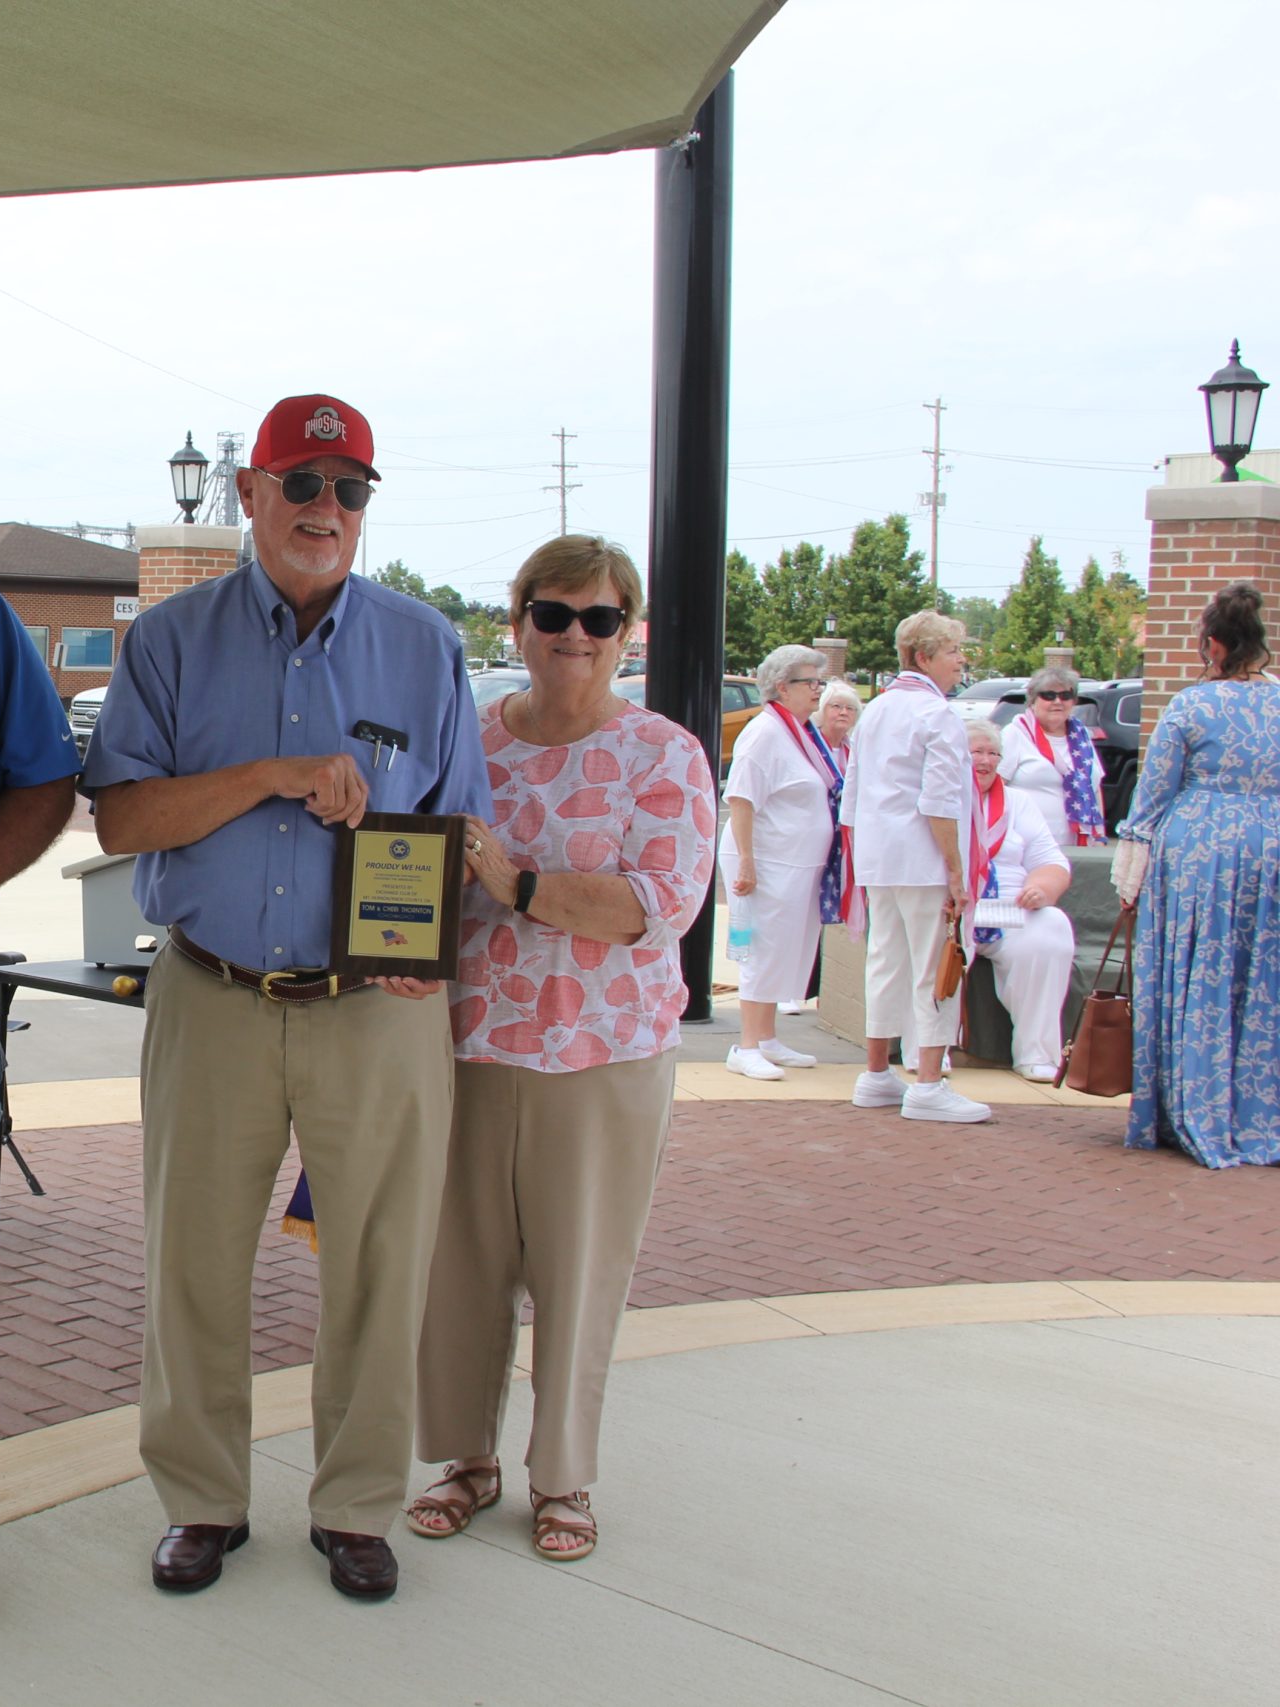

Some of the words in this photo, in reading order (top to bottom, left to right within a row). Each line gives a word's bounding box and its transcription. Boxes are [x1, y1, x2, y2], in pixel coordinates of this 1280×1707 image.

[304, 417, 322, 438] OHIO
[323, 415, 347, 442] STATE
[116, 603, 133, 613] CES
[366, 862, 400, 870] PROUDLY
